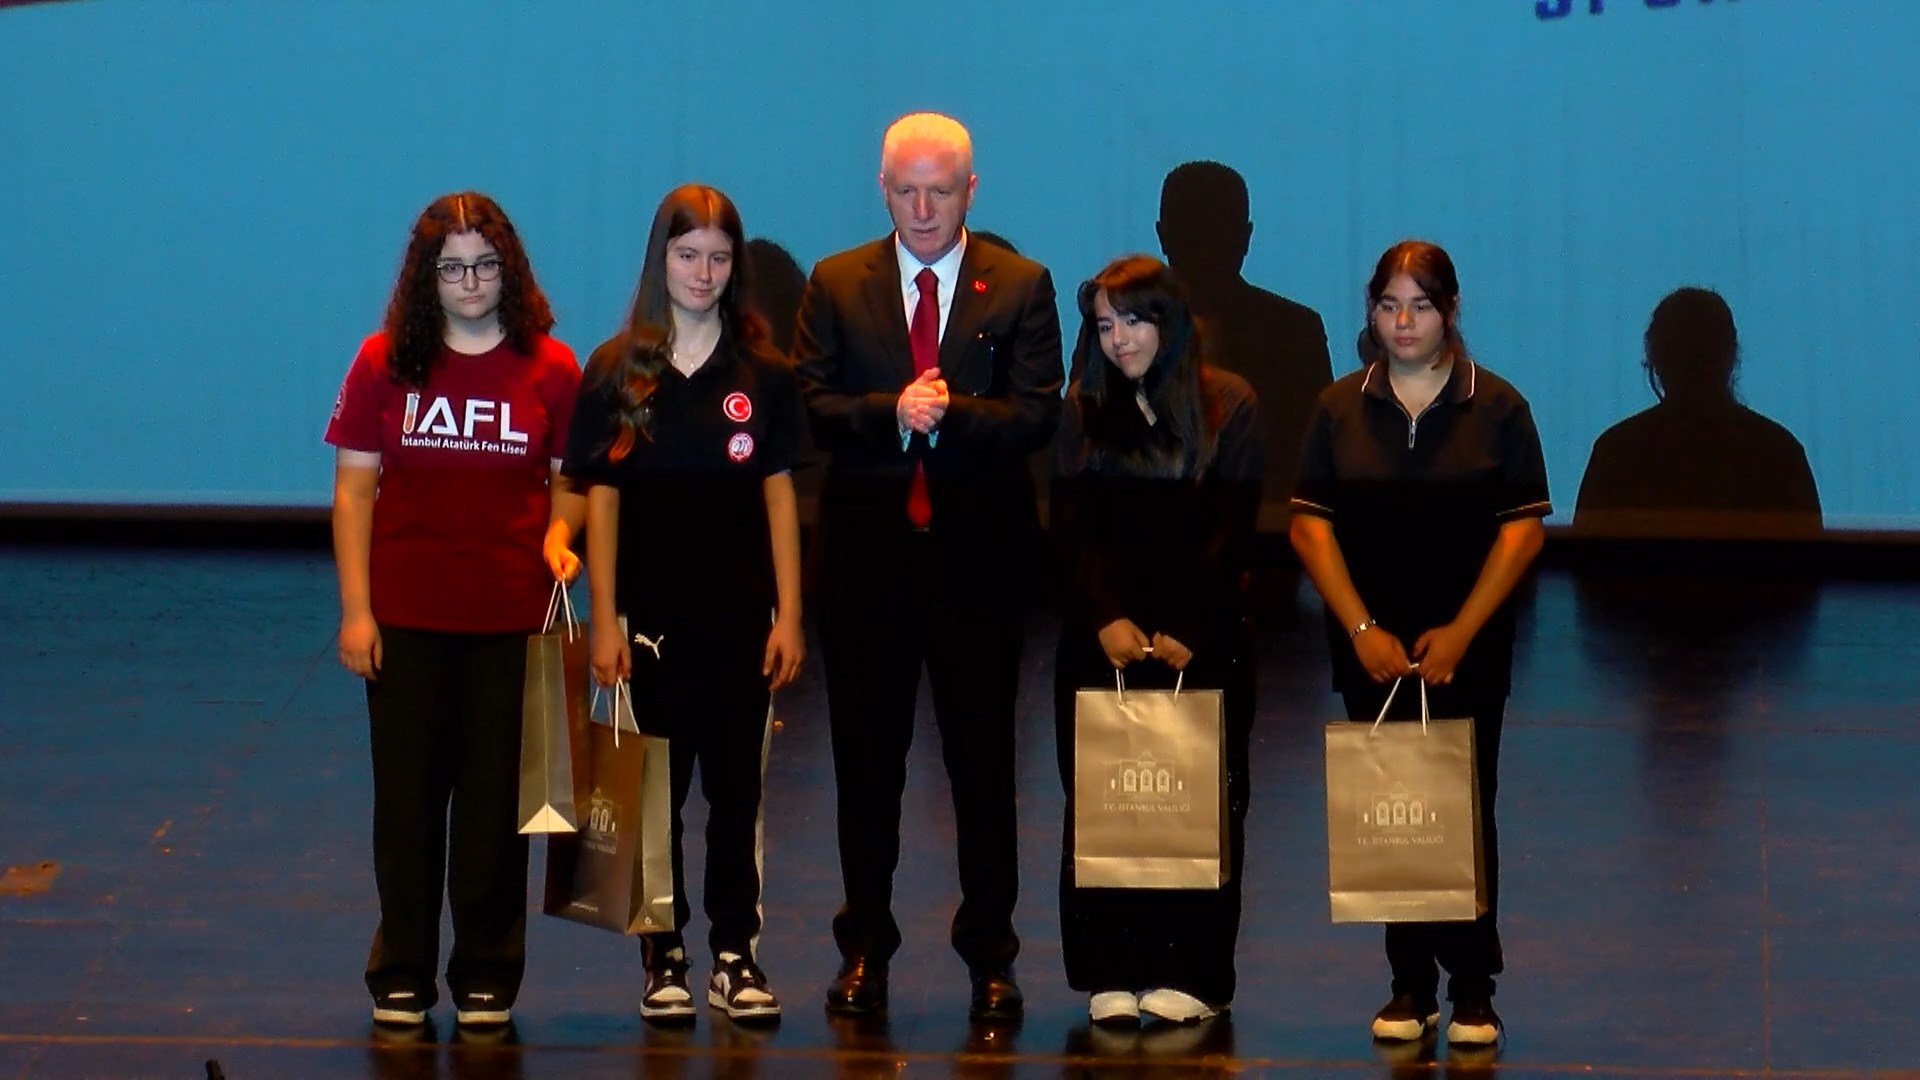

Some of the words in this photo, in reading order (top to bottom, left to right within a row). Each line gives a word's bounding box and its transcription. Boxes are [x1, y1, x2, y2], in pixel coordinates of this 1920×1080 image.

[442, 439, 480, 451] Atatürk
[481, 441, 500, 453] Fen
[501, 443, 527, 456] Lisesi
